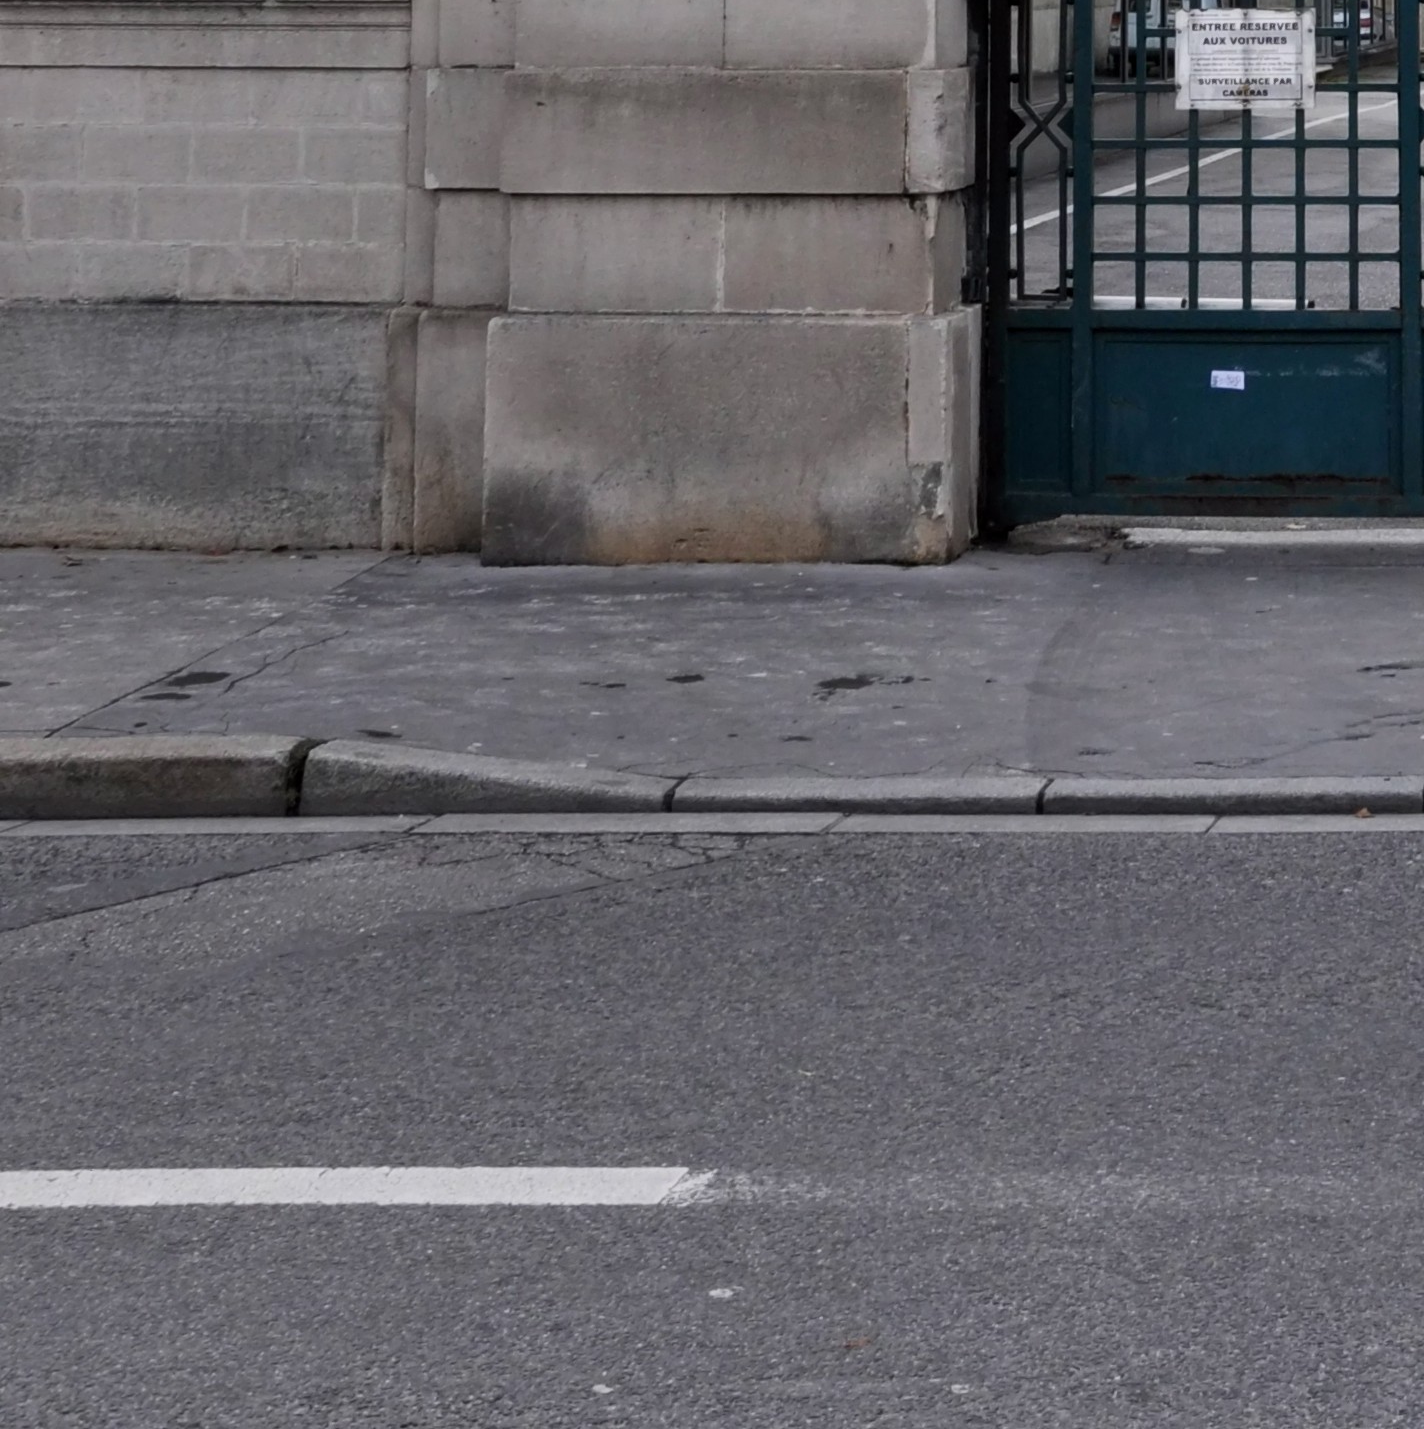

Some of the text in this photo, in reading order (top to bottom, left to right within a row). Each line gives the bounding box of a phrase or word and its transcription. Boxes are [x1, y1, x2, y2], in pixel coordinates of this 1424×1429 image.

[1203, 36, 1288, 45] AUX VOITURES
[1198, 77, 1293, 86] SURVEILLANCE PAR
